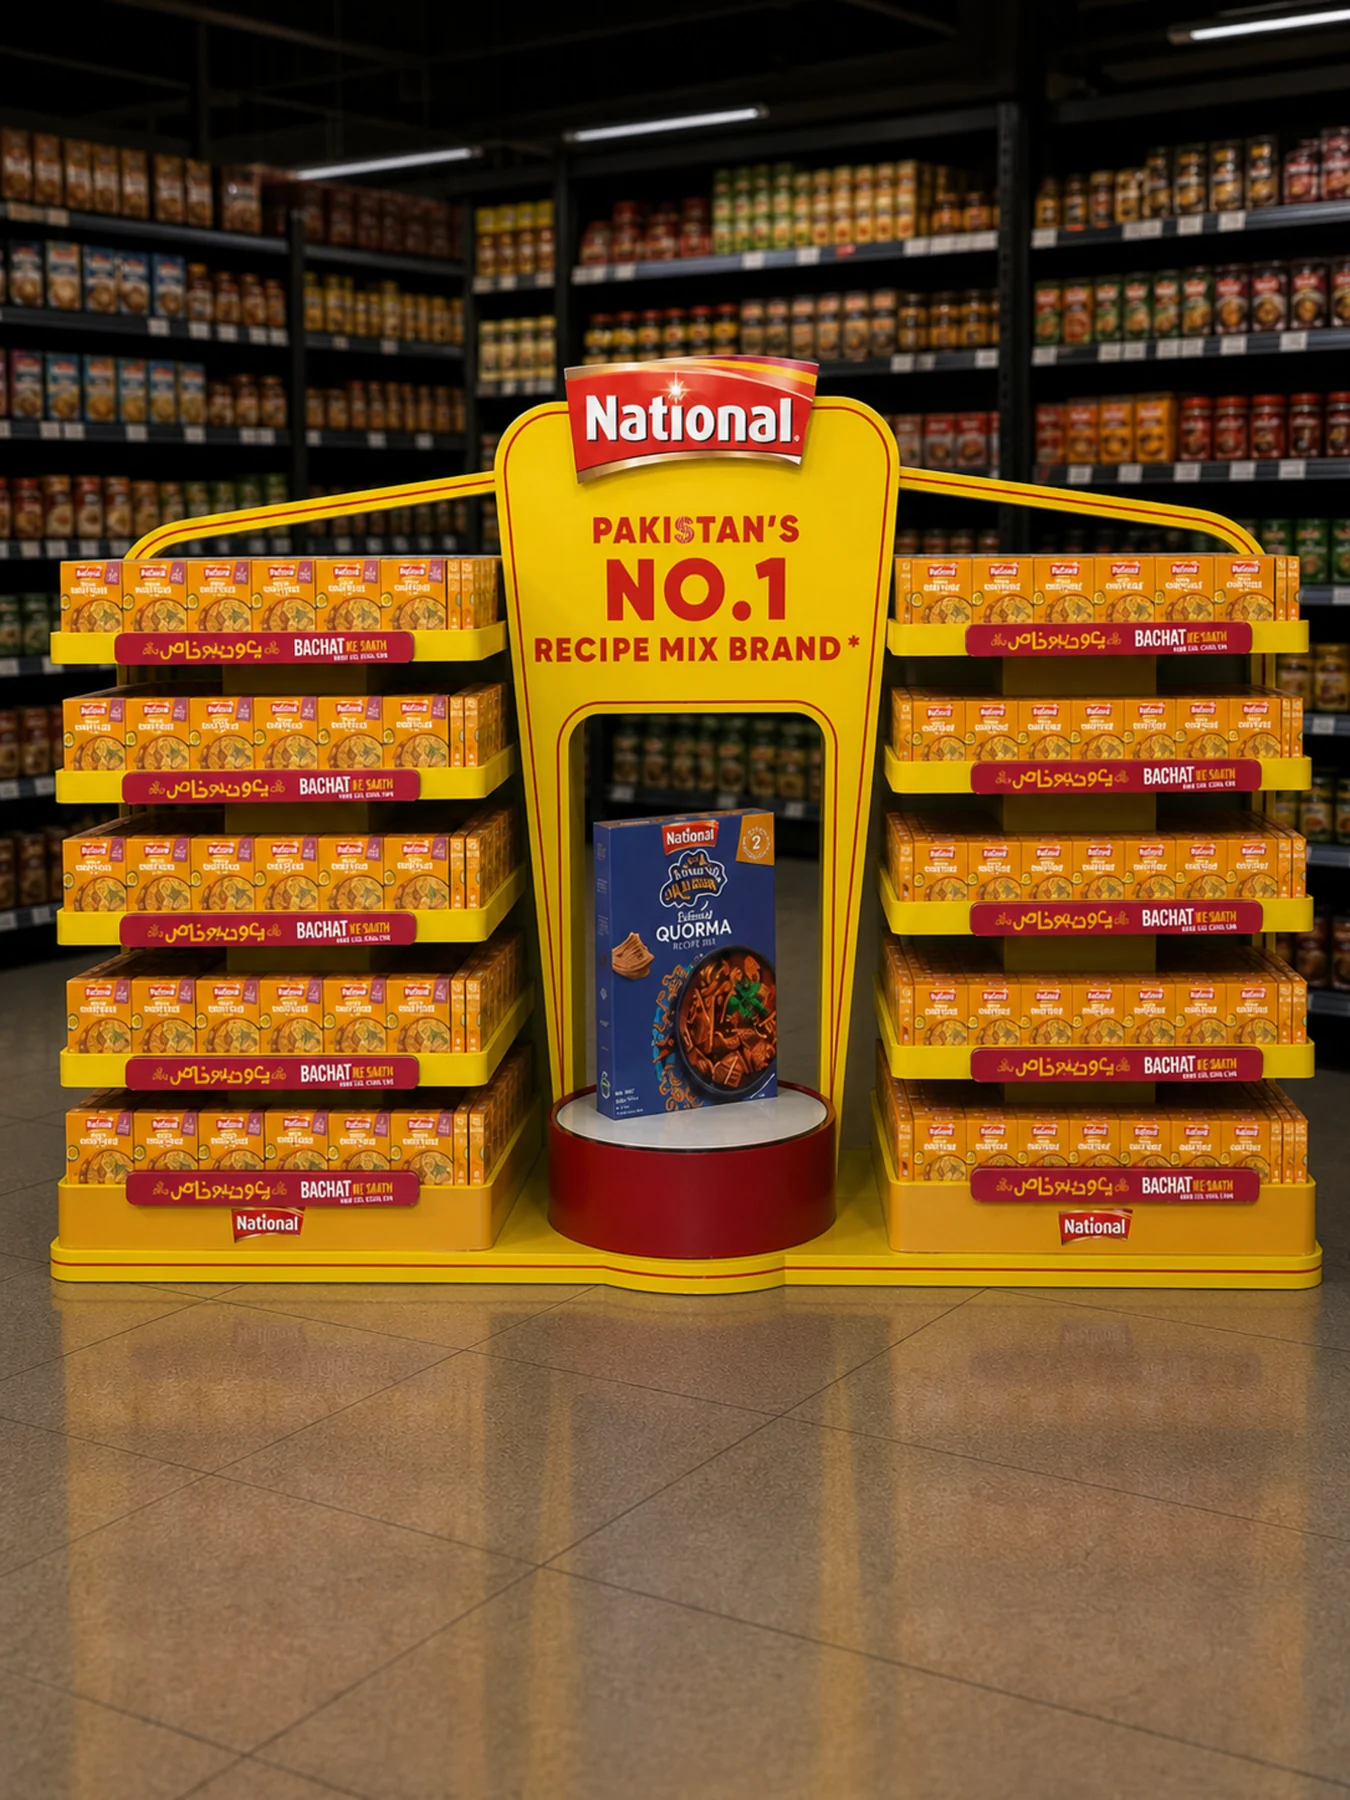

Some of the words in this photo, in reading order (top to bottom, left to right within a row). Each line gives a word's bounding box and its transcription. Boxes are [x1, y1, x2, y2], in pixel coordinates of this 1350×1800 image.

[585, 393, 793, 443] National
[593, 514, 800, 544] PAKISTAN'S
[606, 557, 786, 622] NO.1
[294, 638, 345, 657] BACHAT
[1135, 629, 1187, 647] BACHAT
[534, 637, 649, 662] RECIPE
[660, 636, 718, 662] MIX
[1143, 766, 1194, 785] BACHAT
[299, 776, 350, 795] BACHAT
[666, 827, 714, 845] National
[751, 835, 762, 850] 2
[1142, 908, 1194, 927] BACHAT
[296, 920, 348, 939] BACHAT
[656, 919, 732, 943] QUORMA
[300, 1063, 352, 1083] BACHAT
[1144, 1055, 1196, 1074] BACHAT
[300, 1180, 352, 1199] BACHAT
[1142, 1176, 1193, 1195] BACHAT
[236, 1214, 299, 1232] National
[1064, 1218, 1126, 1236] National
